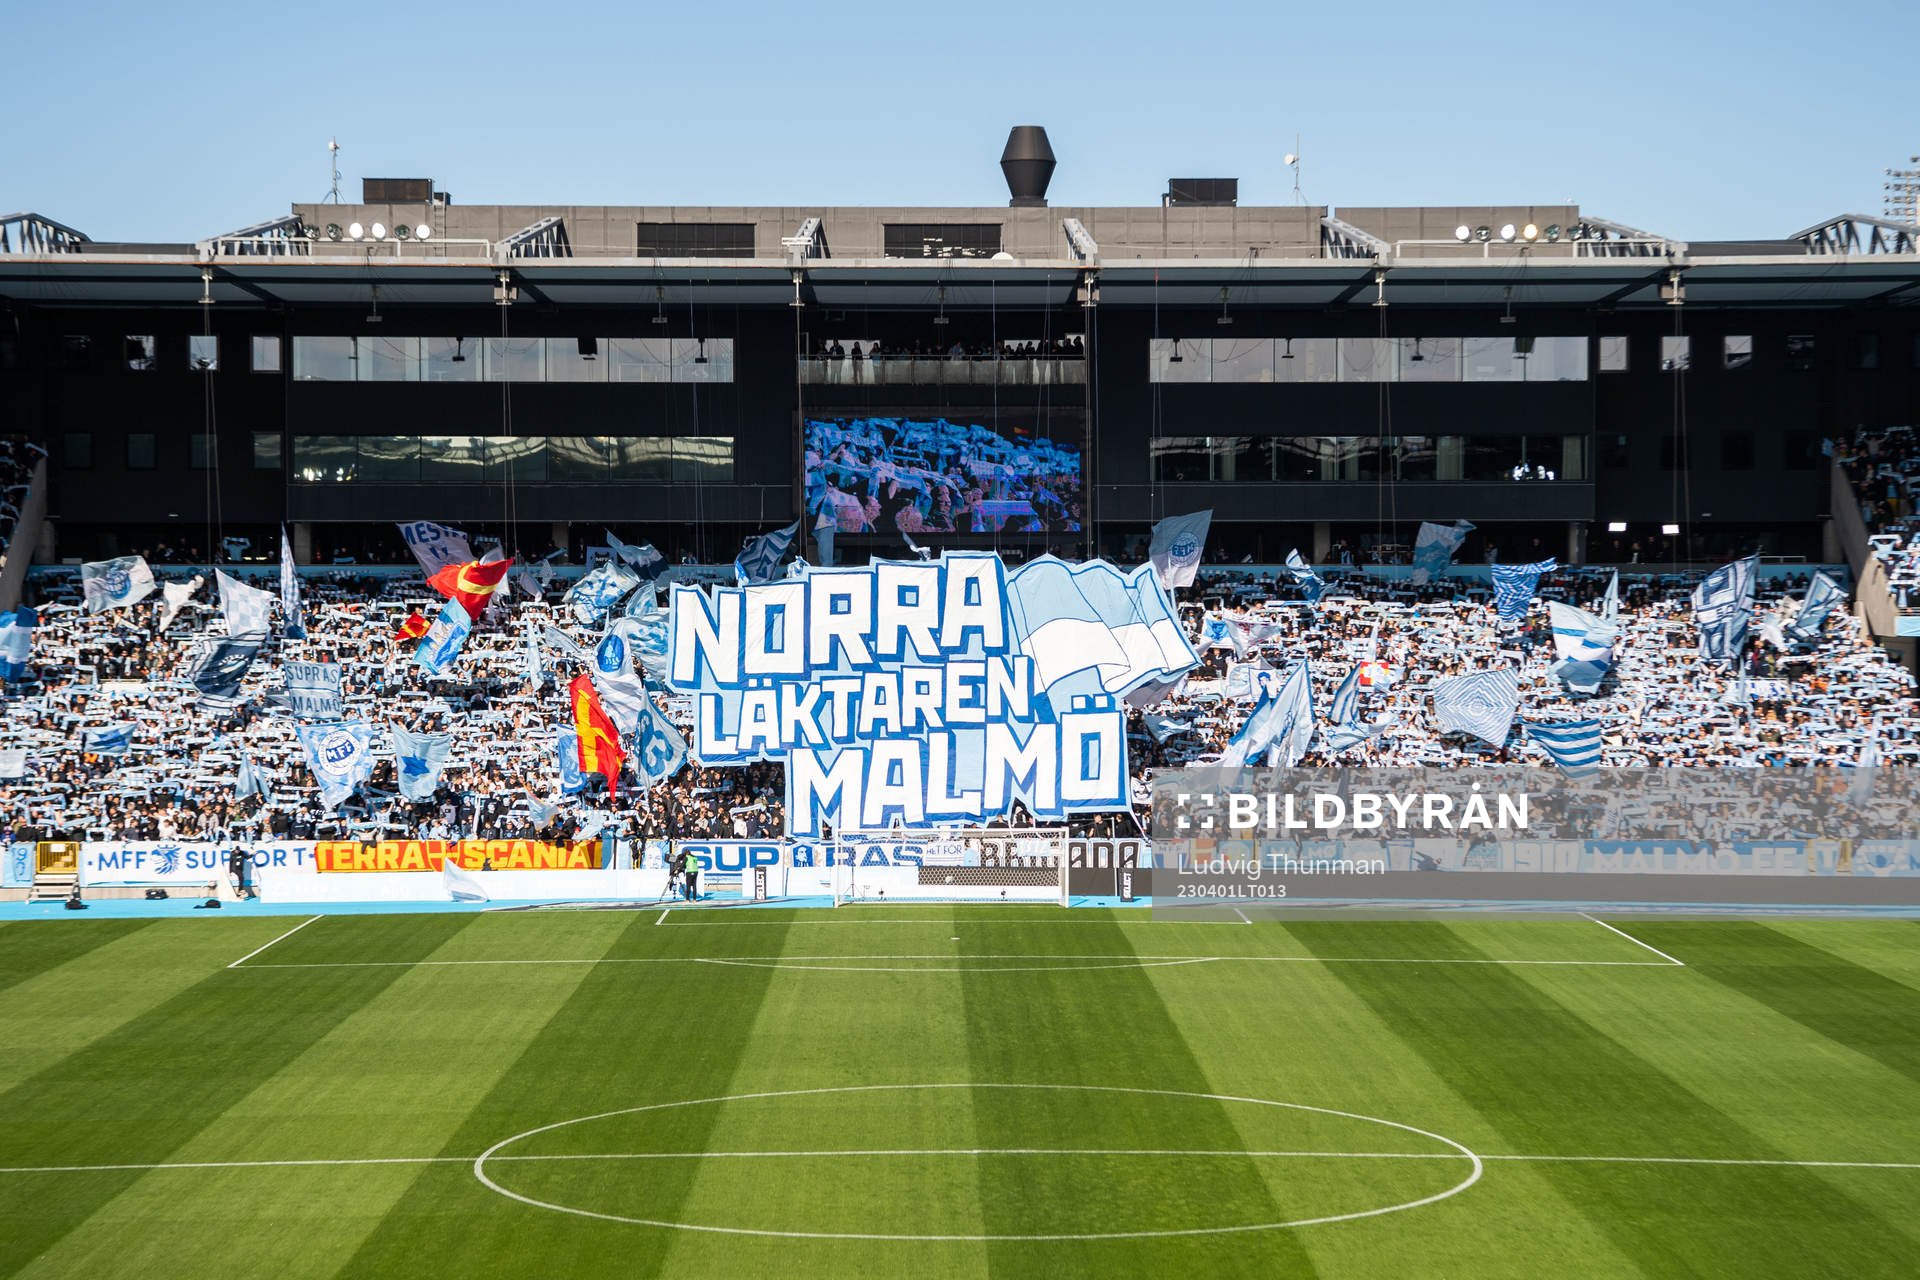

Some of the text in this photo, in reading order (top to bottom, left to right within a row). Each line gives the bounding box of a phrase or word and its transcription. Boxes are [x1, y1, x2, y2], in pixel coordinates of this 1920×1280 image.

[672, 556, 1006, 688] NORRA
[286, 665, 338, 684] SUPRAS
[699, 655, 1033, 758] LÄKTAREN
[327, 740, 352, 760] MFF
[790, 695, 1124, 835] MALMÖ
[98, 848, 306, 871] MFF SUPORT
[317, 840, 592, 870] TERRA SCANIA
[1593, 841, 1741, 874] MALMÖ
[756, 870, 765, 899] SELECT
